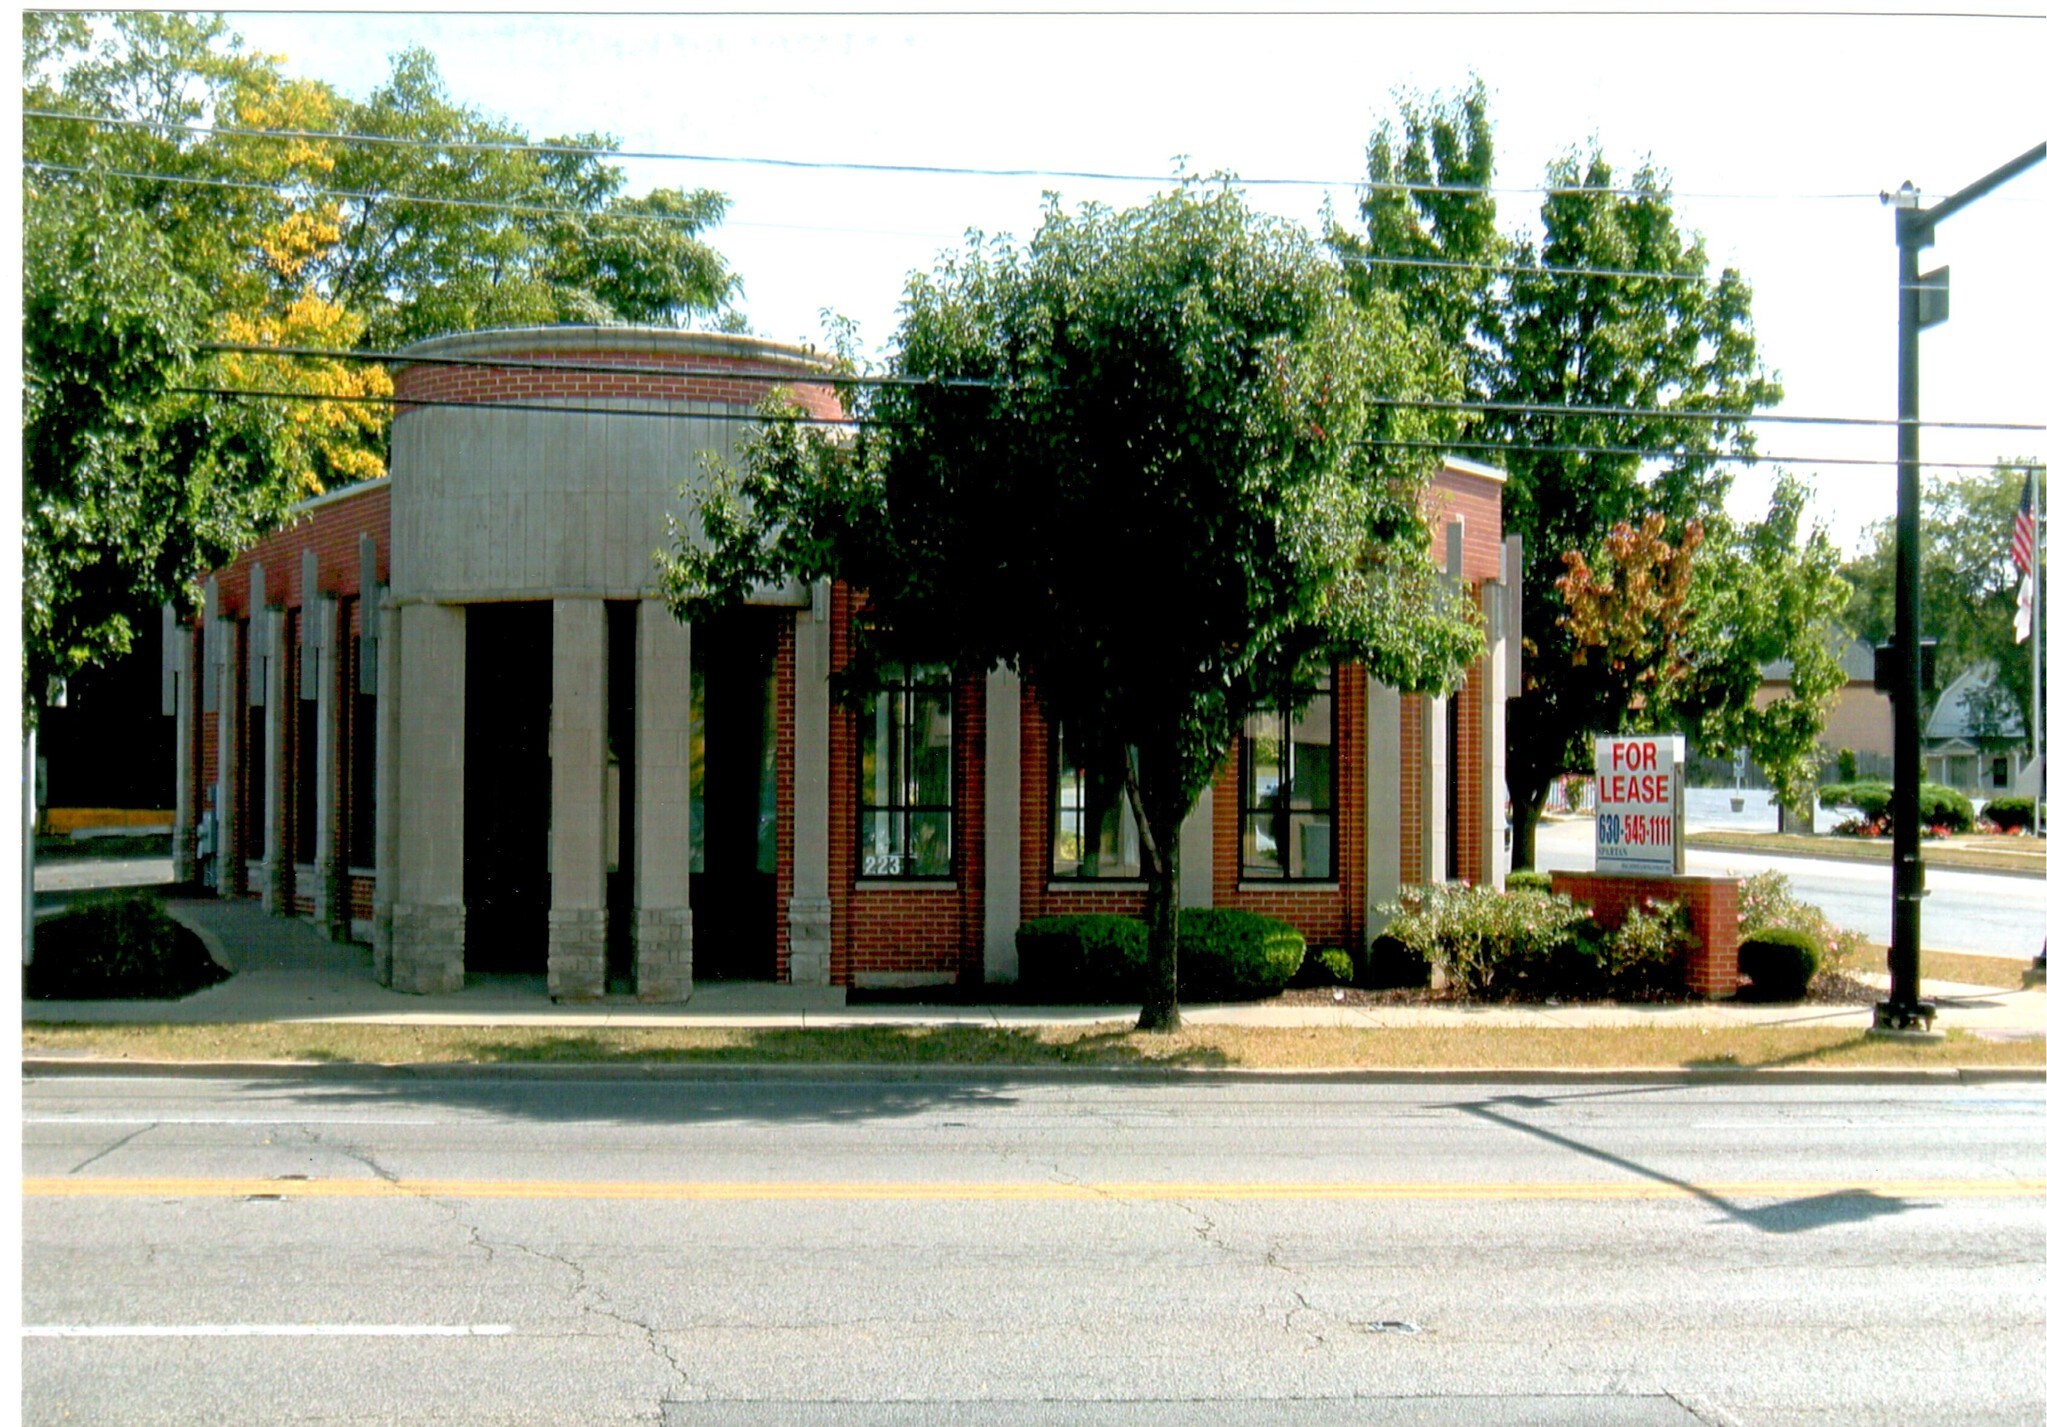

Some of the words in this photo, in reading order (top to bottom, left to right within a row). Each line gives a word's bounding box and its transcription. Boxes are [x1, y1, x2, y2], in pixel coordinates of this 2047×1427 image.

[1612, 742, 1657, 771] FOR
[1600, 775, 1669, 804] LEASE
[863, 855, 900, 876] 223
